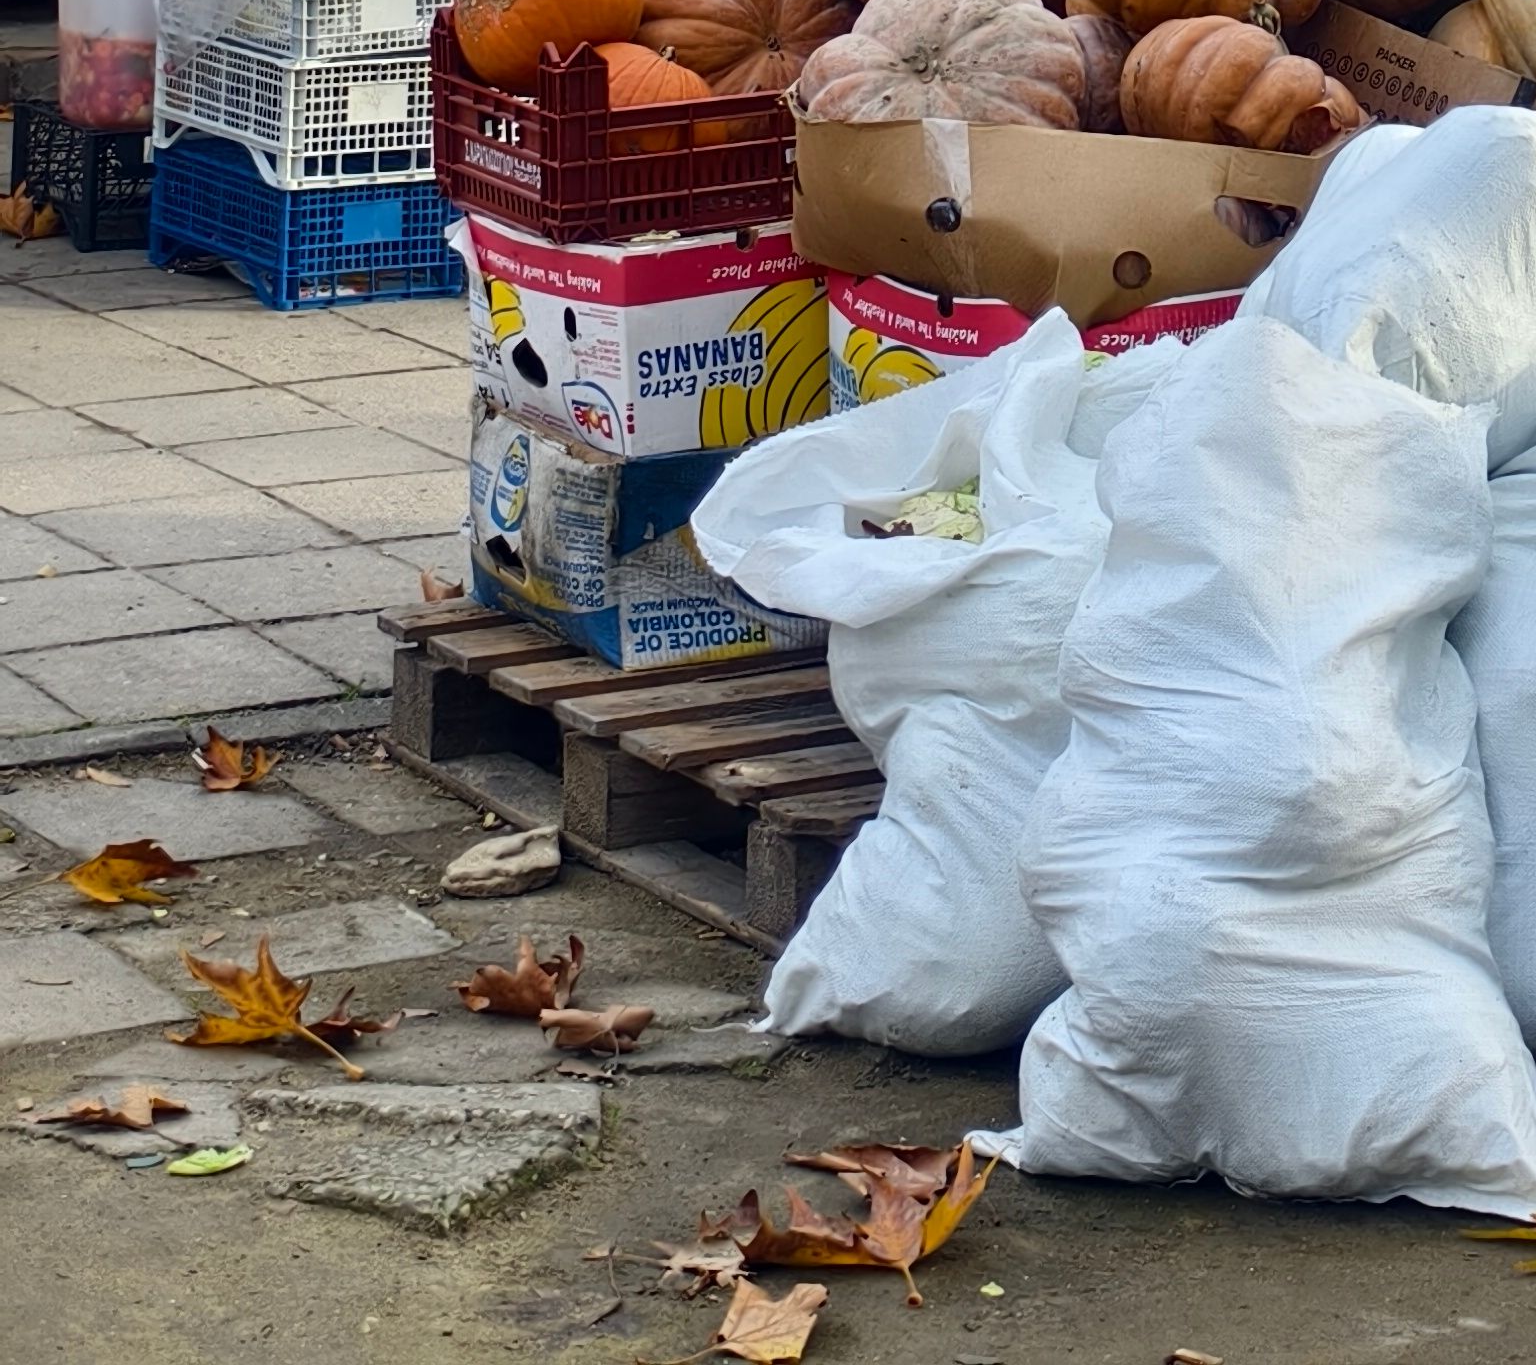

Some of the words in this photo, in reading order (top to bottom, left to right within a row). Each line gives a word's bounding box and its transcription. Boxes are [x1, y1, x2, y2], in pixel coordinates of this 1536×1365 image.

[563, 269, 602, 293] Making
[712, 260, 753, 283] Place
[638, 332, 764, 379] BANANAS
[639, 375, 698, 399] Extra
[708, 364, 764, 388] Class
[571, 403, 613, 441] Dole
[630, 599, 664, 614] PACK
[627, 610, 736, 634] COLOMBIA
[634, 633, 663, 653] OF
[667, 625, 767, 649] PRODUCE
